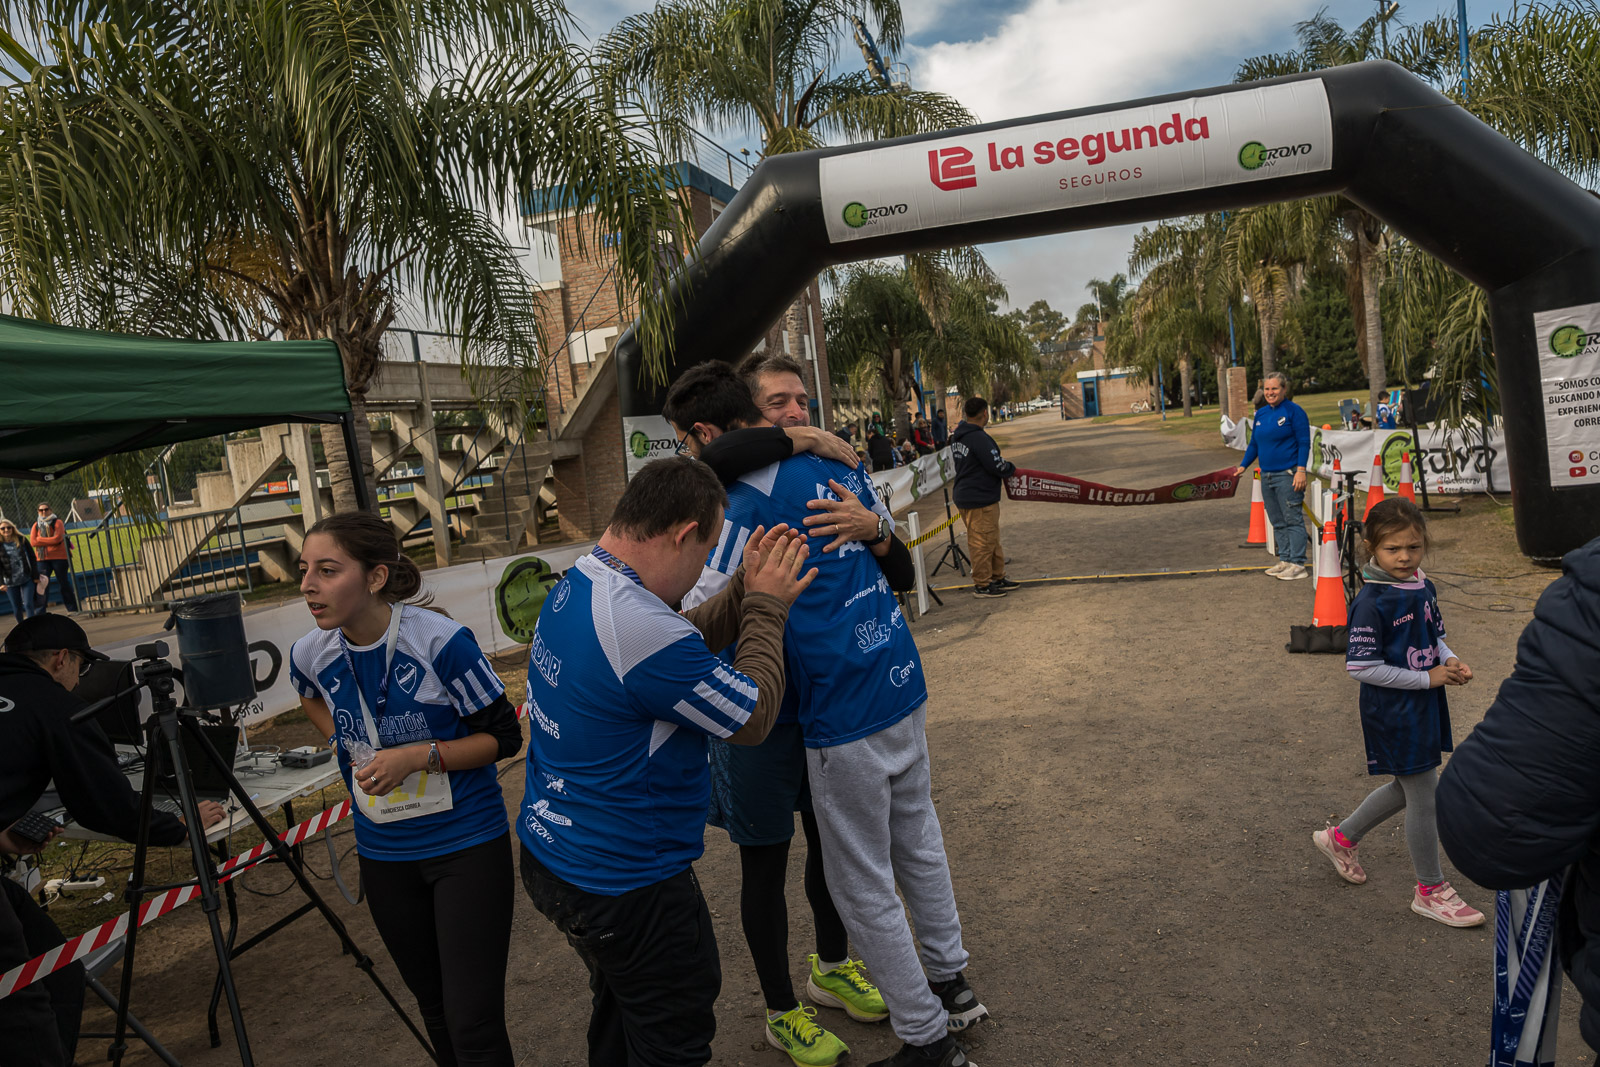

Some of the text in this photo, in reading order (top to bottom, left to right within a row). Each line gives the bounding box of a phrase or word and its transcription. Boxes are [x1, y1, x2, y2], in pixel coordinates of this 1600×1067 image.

[987, 112, 1210, 172] la segunda
[1257, 160, 1277, 169] RAV
[1059, 166, 1143, 190] SEGUROS
[1575, 346, 1599, 356] RAV
[1548, 391, 1595, 405] BUSCANDO
[643, 438, 681, 451] CRON
[1009, 487, 1028, 496] VOS
[1088, 488, 1156, 503] LLEGADA
[1393, 612, 1415, 627] KION
[356, 710, 428, 737] MRATÓN
[549, 720, 560, 732] DE
